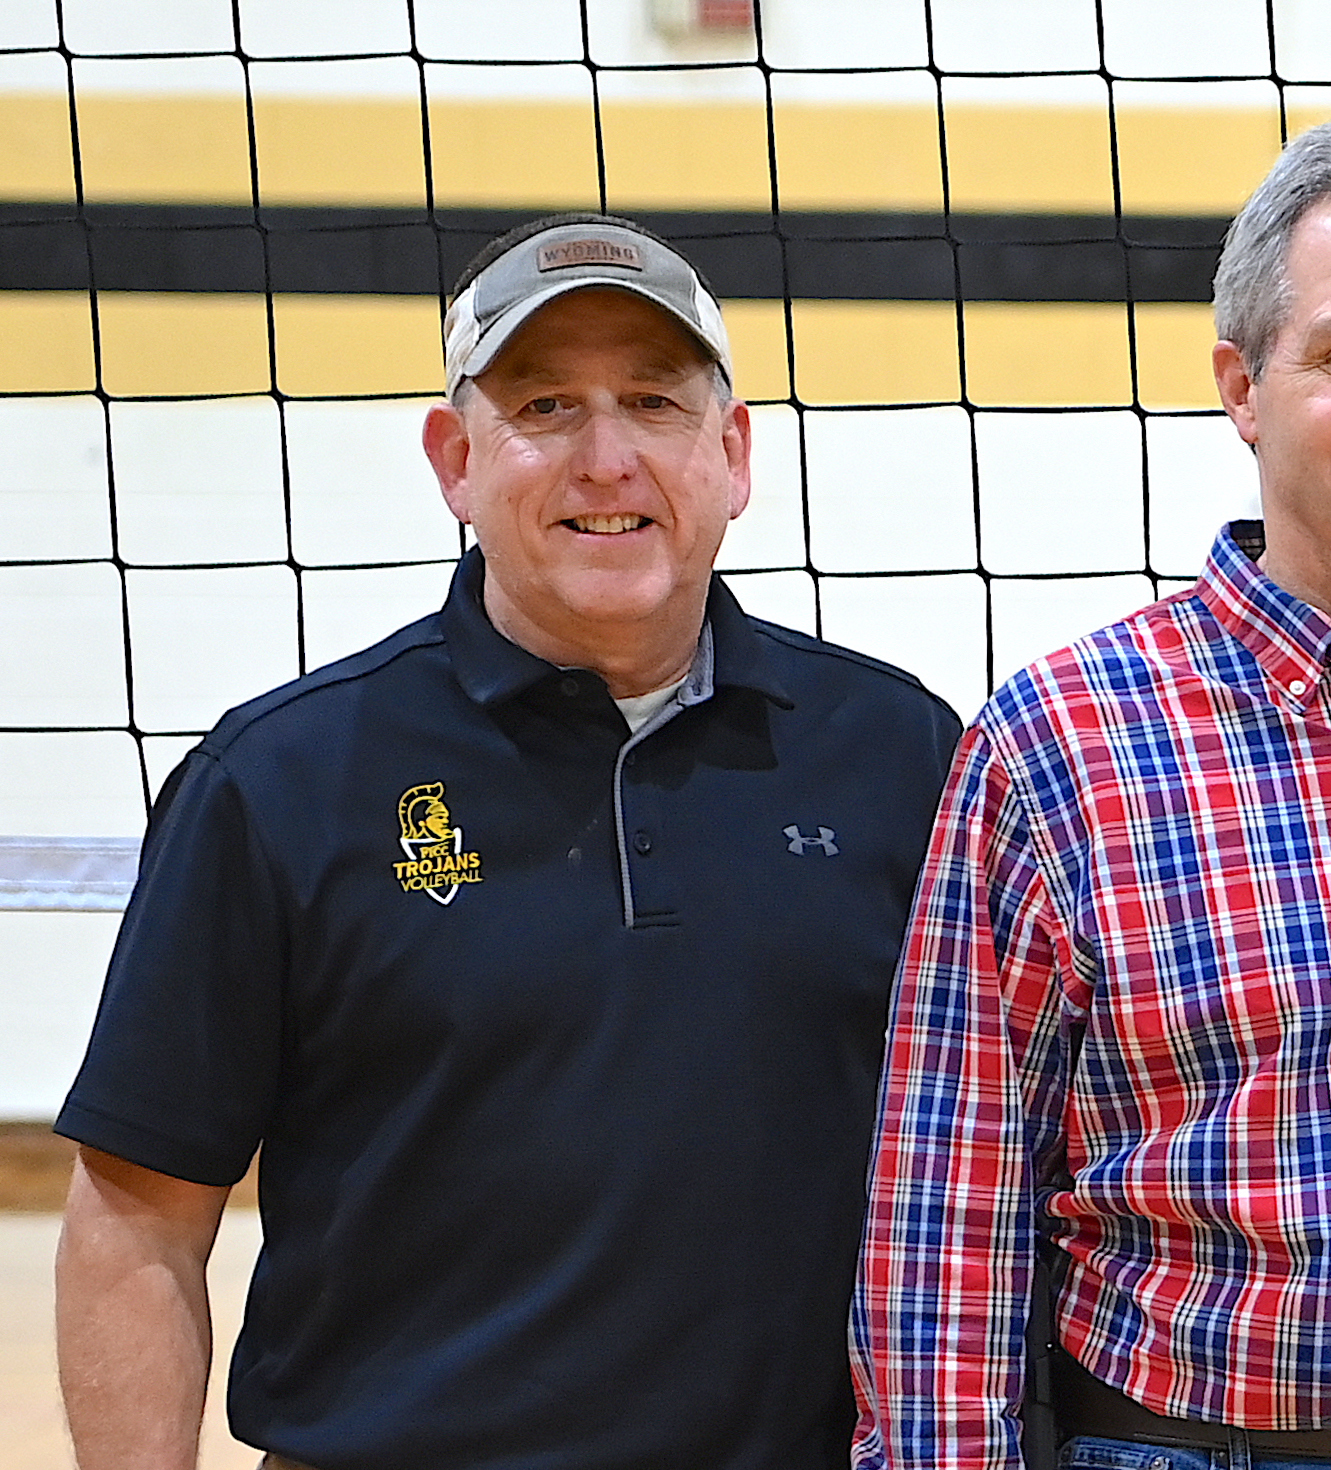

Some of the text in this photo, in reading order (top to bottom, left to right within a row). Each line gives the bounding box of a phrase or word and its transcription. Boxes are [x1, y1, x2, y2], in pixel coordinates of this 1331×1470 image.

[545, 244, 634, 261] WYOMING
[393, 852, 480, 879] TROJANS
[401, 869, 484, 892] VOLLEYBALL
